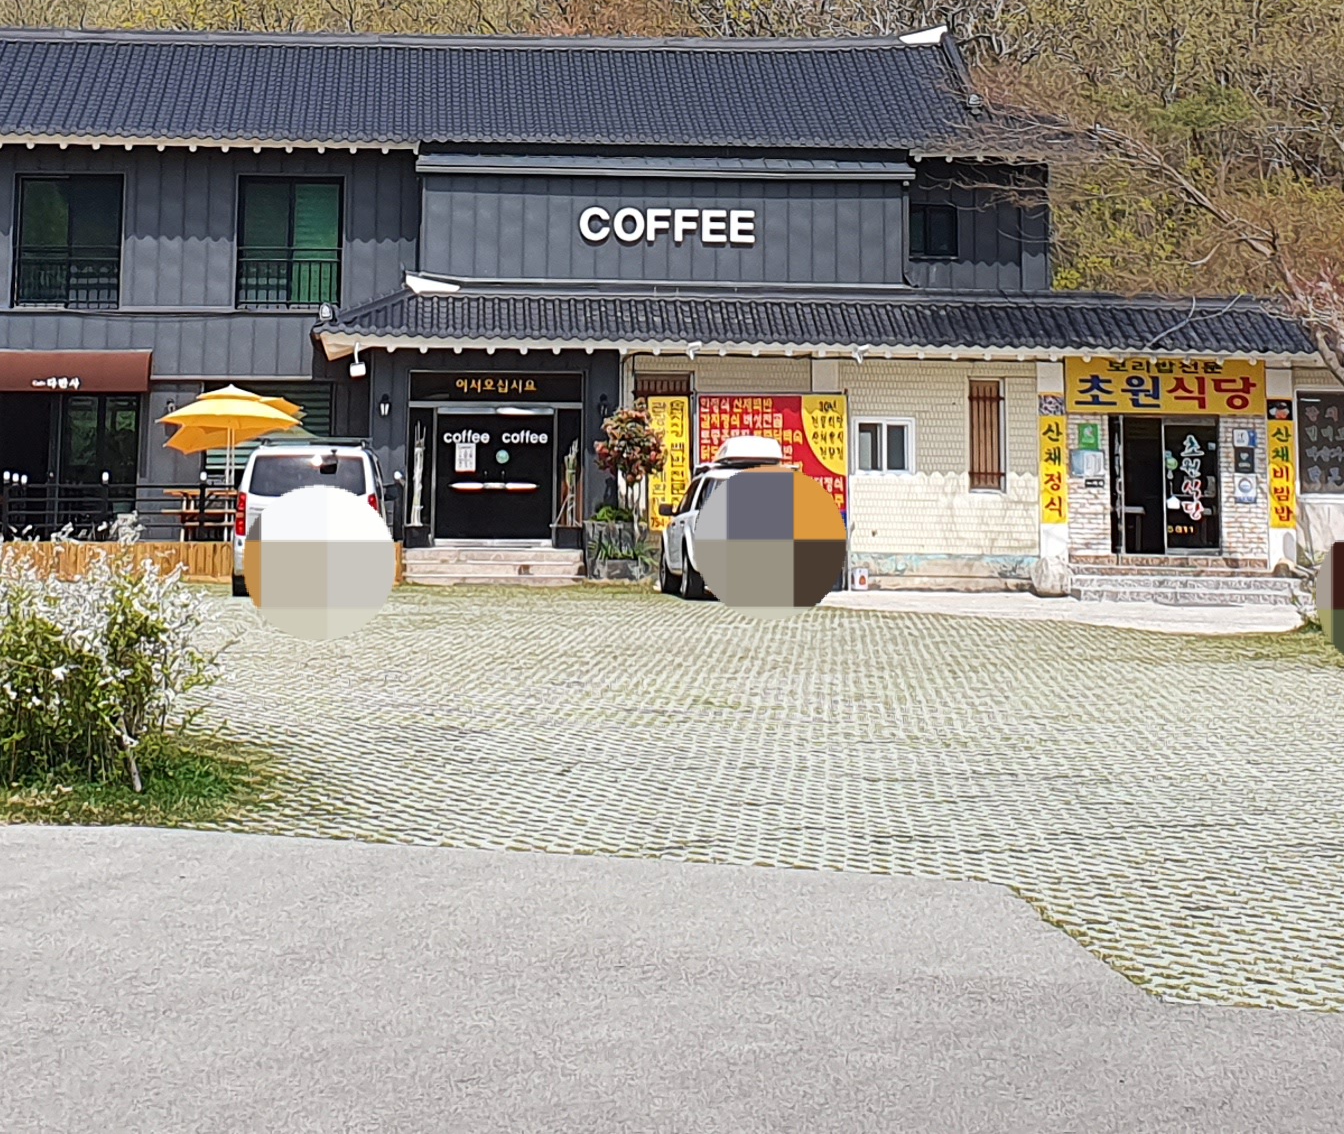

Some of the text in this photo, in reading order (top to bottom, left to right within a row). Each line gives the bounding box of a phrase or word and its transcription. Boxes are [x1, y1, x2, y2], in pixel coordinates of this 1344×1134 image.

[579, 207, 756, 243] COFFEE
[1074, 374, 1257, 410] 초원식당
[443, 429, 548, 444] coffee coffee
[1042, 421, 1063, 518] 산채정식
[1180, 434, 1205, 521] 초원식당
[1271, 426, 1293, 522] 산채비빔밥
